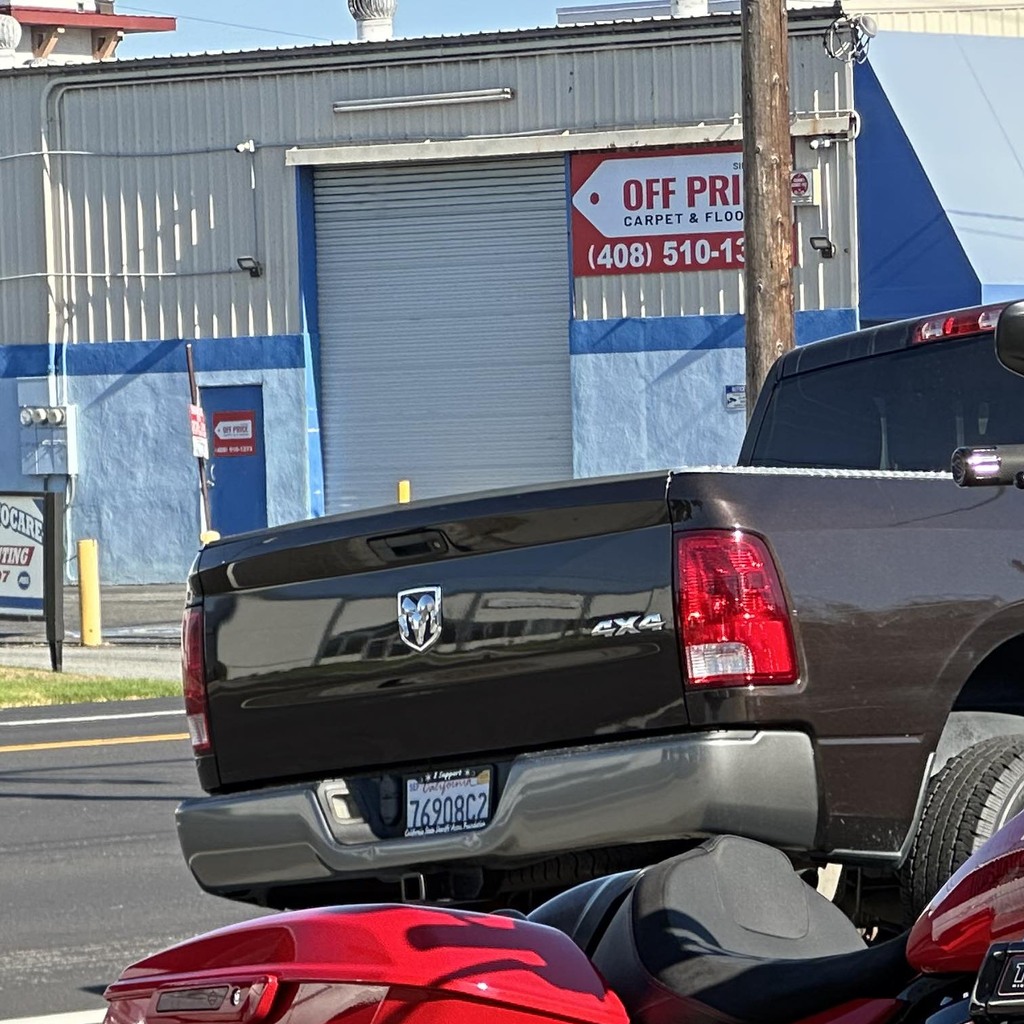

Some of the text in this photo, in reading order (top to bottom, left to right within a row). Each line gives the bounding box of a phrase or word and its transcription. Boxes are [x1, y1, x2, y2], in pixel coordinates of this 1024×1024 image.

[623, 174, 741, 212] OFF PRI
[624, 213, 683, 227] CARPET
[689, 212, 698, 224] &
[588, 241, 653, 270] (408)
[410, 792, 487, 828] 76908C2
